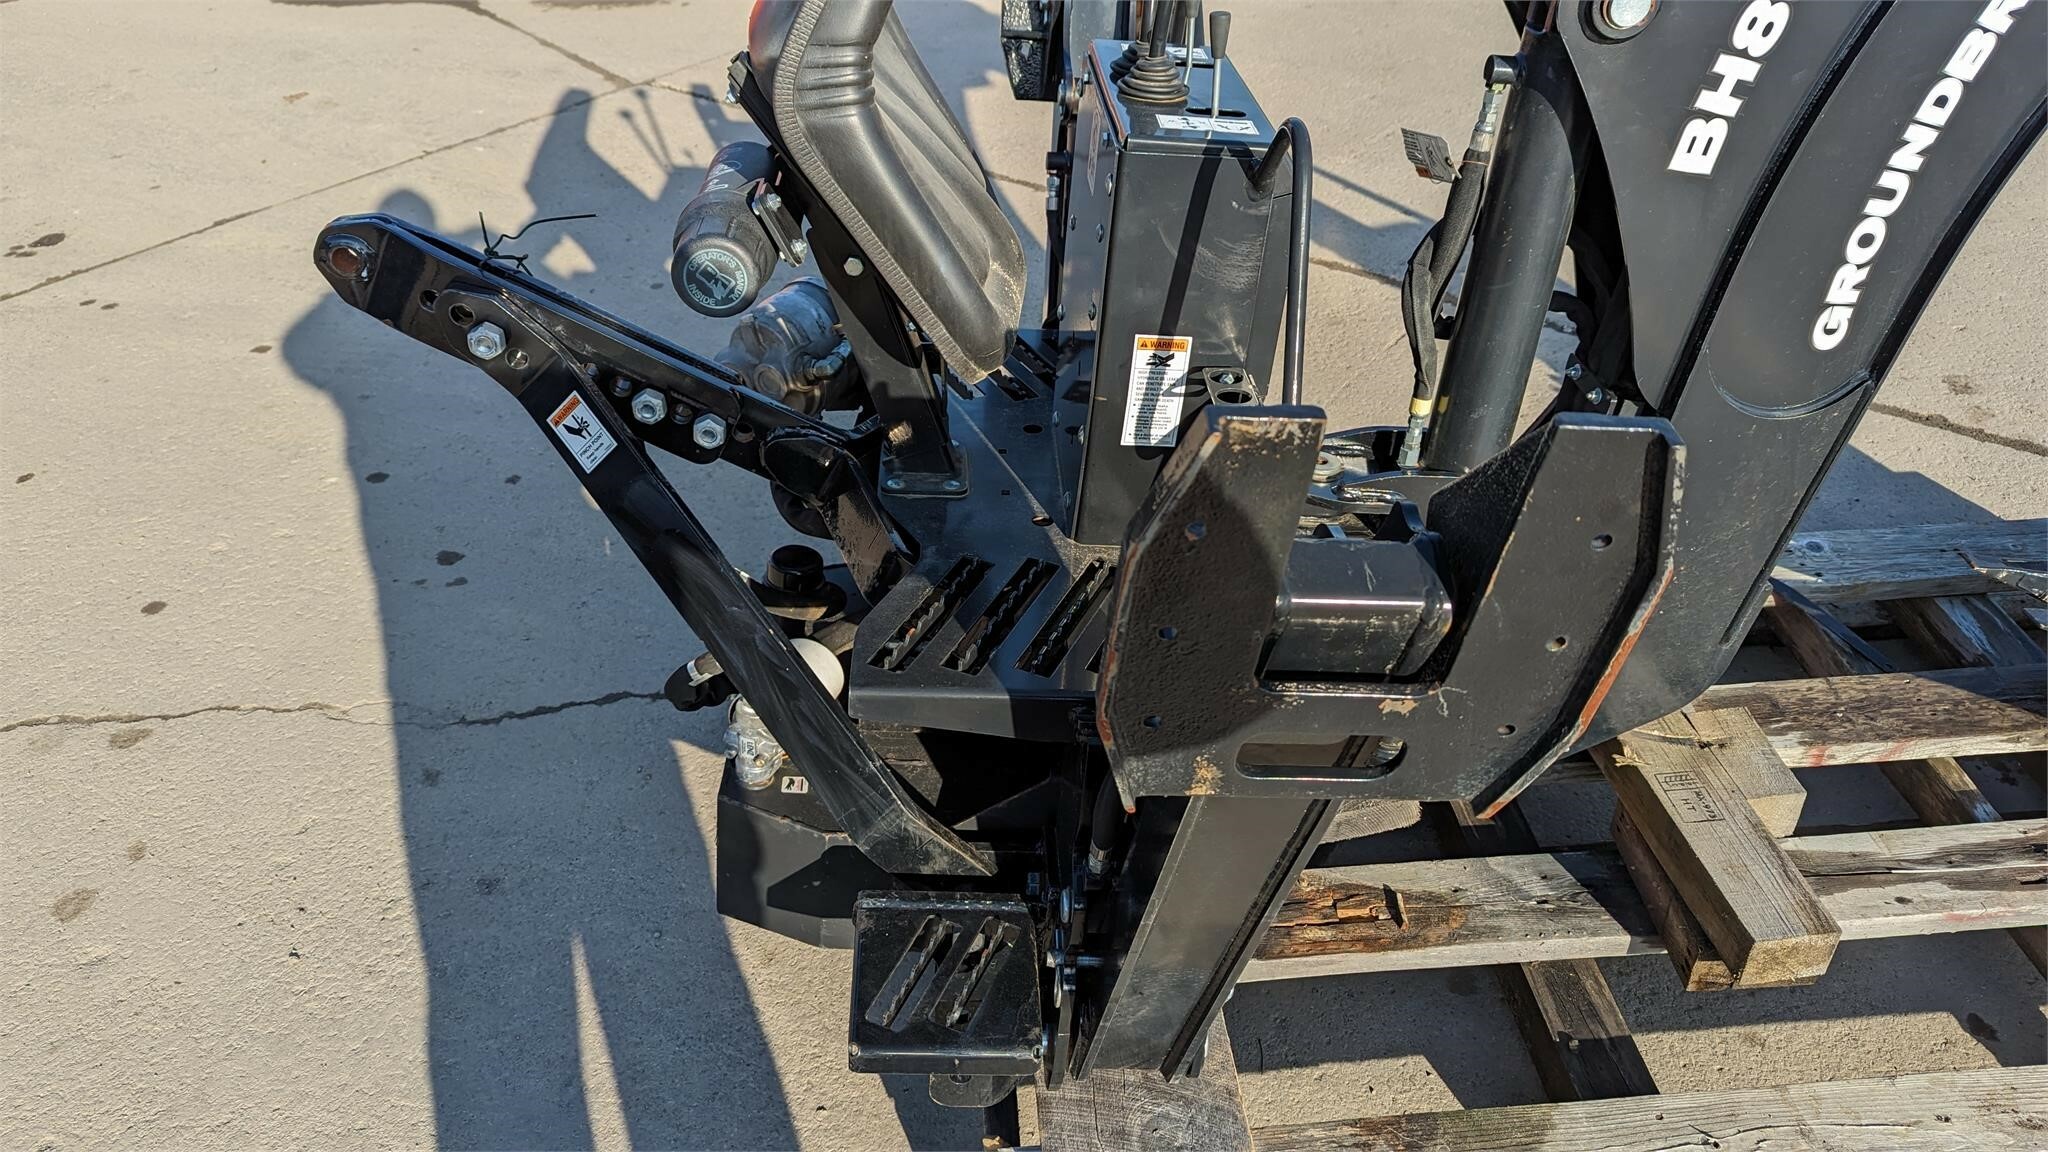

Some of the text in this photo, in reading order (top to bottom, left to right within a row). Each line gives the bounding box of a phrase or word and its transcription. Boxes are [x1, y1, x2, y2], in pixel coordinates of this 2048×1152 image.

[689, 251, 744, 300] OPERATOR'S MANUAL
[688, 283, 716, 306] INSIDE
[1150, 341, 1185, 349] WARNING
[557, 397, 580, 424] WARNING
[580, 443, 593, 457] PINCH
[591, 432, 604, 446] POINT
[1681, 798, 1697, 812] HT
